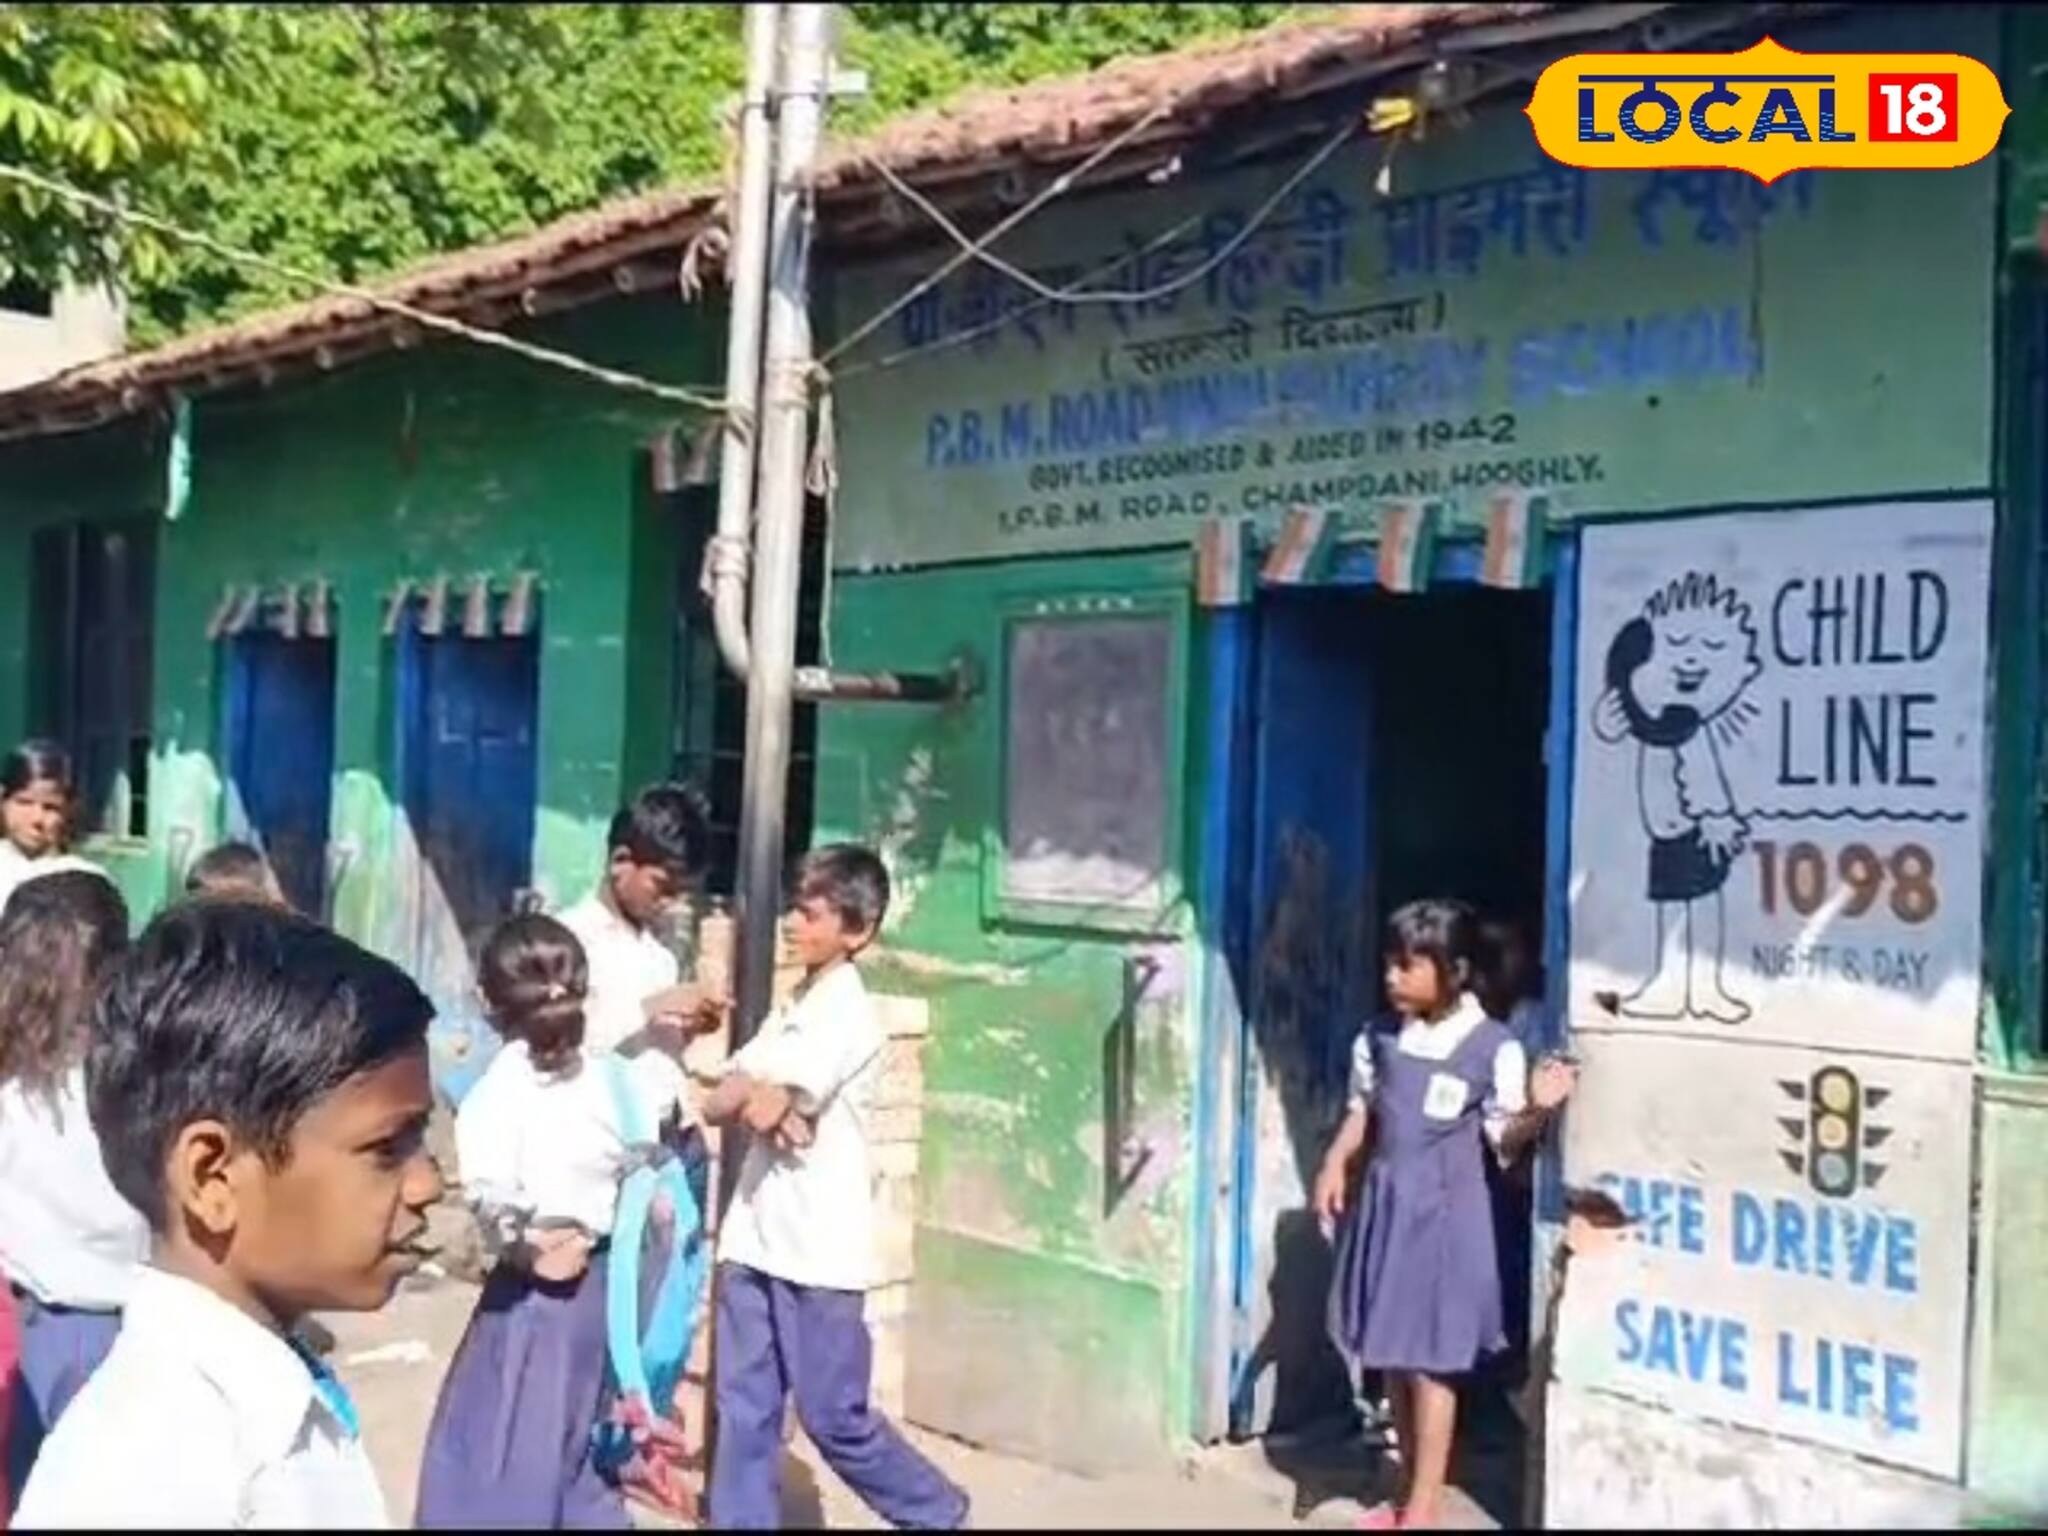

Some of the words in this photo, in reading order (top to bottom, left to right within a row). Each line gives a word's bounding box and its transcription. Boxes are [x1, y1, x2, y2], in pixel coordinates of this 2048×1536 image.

[1416, 412, 1518, 451] 1942
[1771, 570, 1950, 667] CHILD
[1777, 694, 1938, 787] LINE
[1752, 840, 1939, 925] 1098
[1841, 947, 1865, 983] &
[1872, 948, 1931, 991] DAY
[1731, 1190, 1918, 1294] DRIVE
[1615, 1299, 1748, 1393] SAVE
[1777, 1331, 1919, 1433] LIFE
